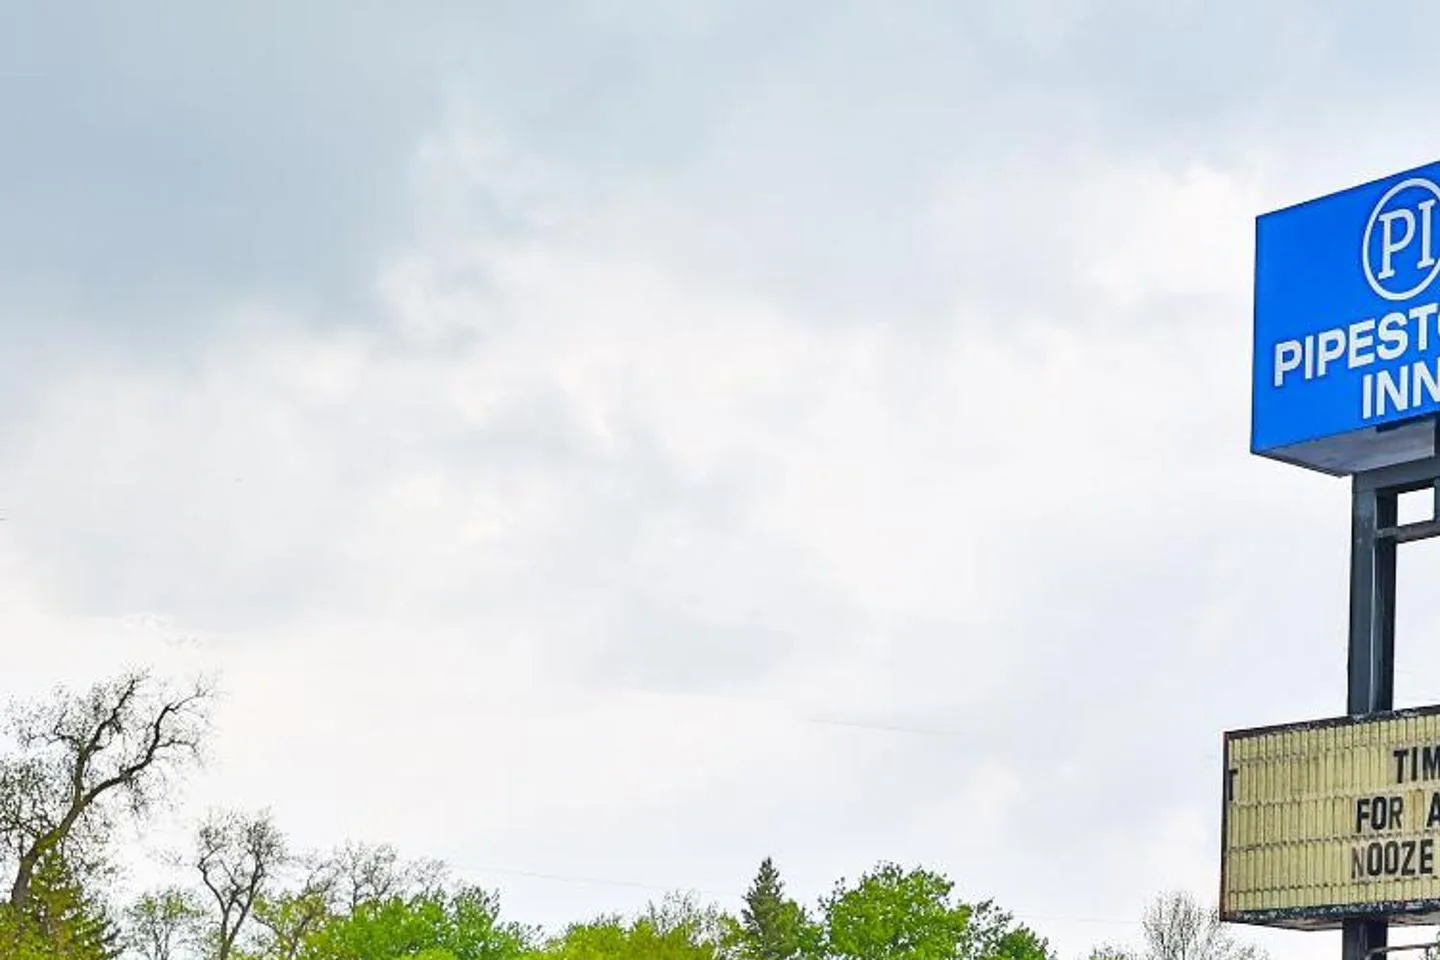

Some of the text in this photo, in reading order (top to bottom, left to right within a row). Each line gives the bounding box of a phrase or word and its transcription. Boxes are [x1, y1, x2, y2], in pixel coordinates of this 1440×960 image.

[1377, 199, 1436, 281] PI
[1355, 797, 1404, 834] FOR
[1351, 838, 1434, 879] NOOZE
